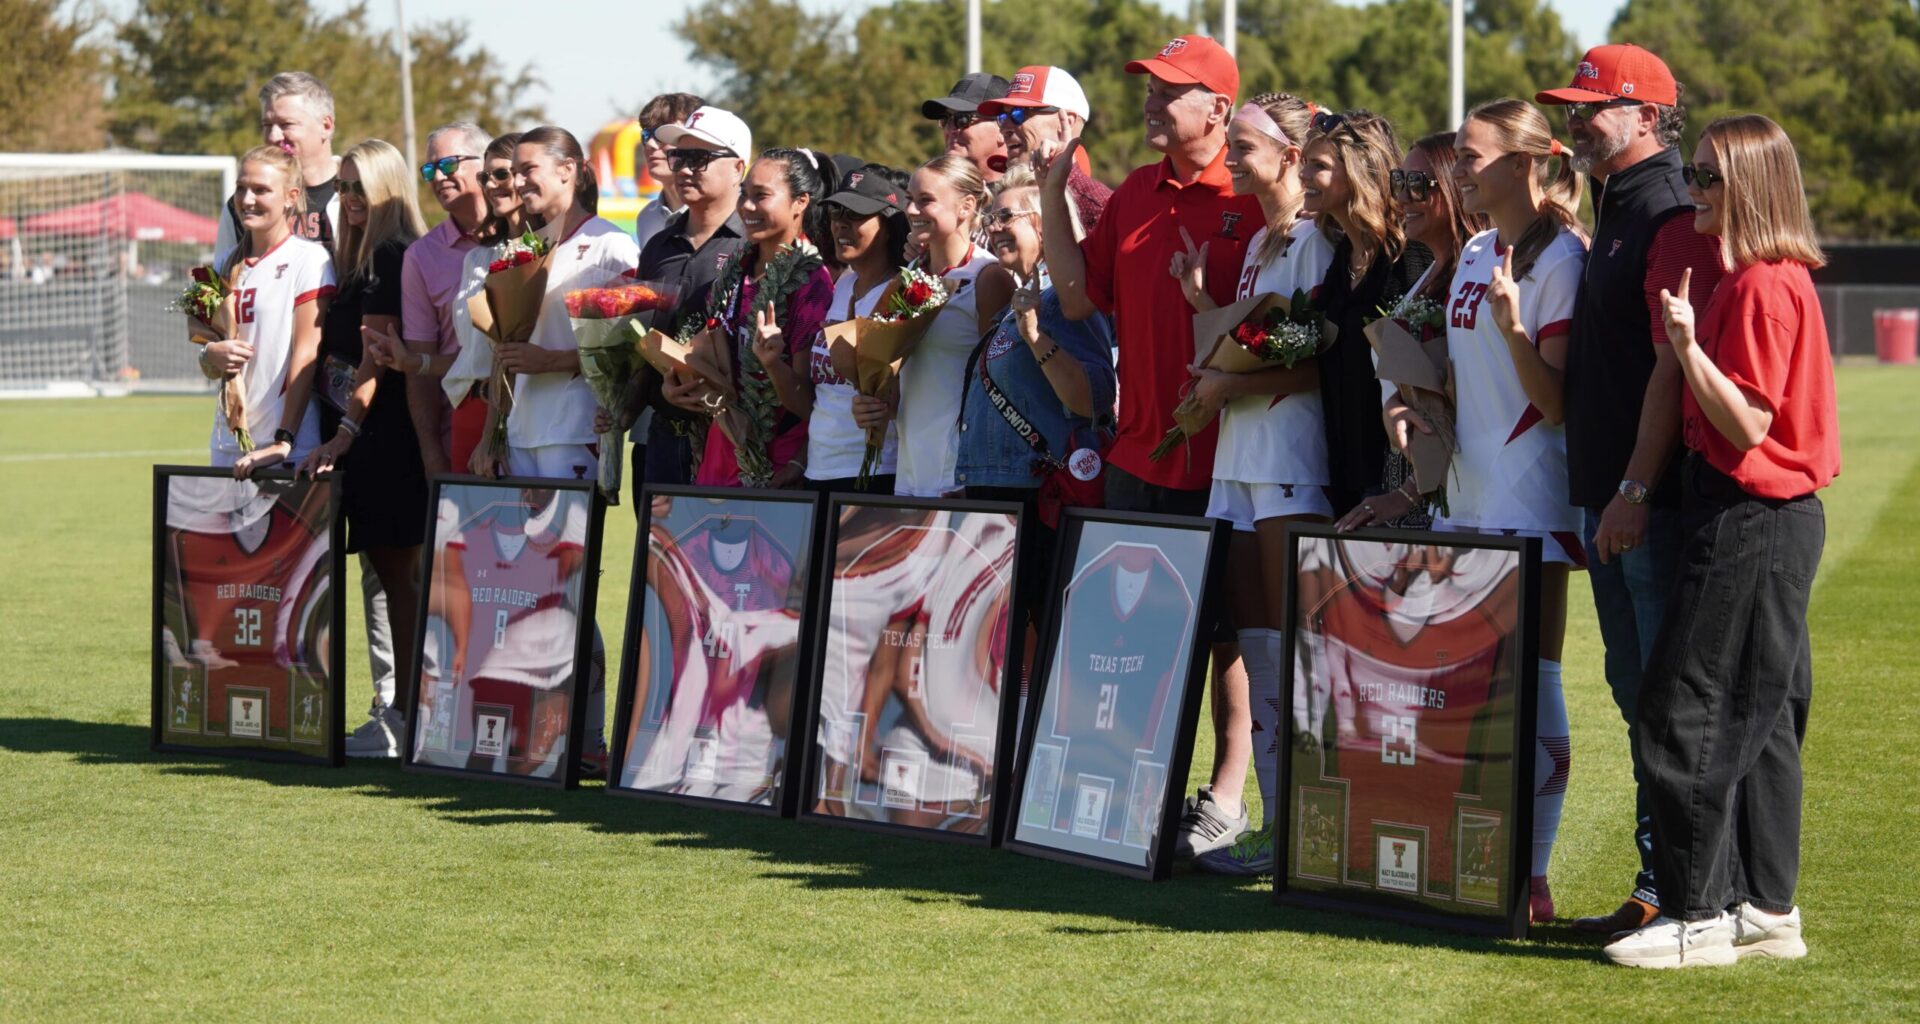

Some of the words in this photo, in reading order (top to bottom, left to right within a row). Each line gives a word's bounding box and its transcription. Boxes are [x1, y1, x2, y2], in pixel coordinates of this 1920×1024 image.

[1237, 264, 1260, 300] 21
[1450, 280, 1487, 330] 23
[1003, 406, 1032, 437] GUNS
[217, 584, 236, 600] RED
[239, 583, 281, 603] RAIDERS
[472, 587, 492, 603] RED
[494, 587, 539, 609] RAIDERS
[235, 608, 262, 646] 32
[494, 609, 508, 650] 8
[703, 622, 735, 660] 40
[883, 629, 921, 649] TEXAS
[925, 632, 955, 650] TECH
[1089, 653, 1119, 674] TEXAS
[1119, 654, 1145, 674] TECH
[1095, 683, 1119, 731] 21
[1359, 682, 1384, 703] RED
[1388, 682, 1446, 710] RAIDERS
[1381, 714, 1416, 766] 23
